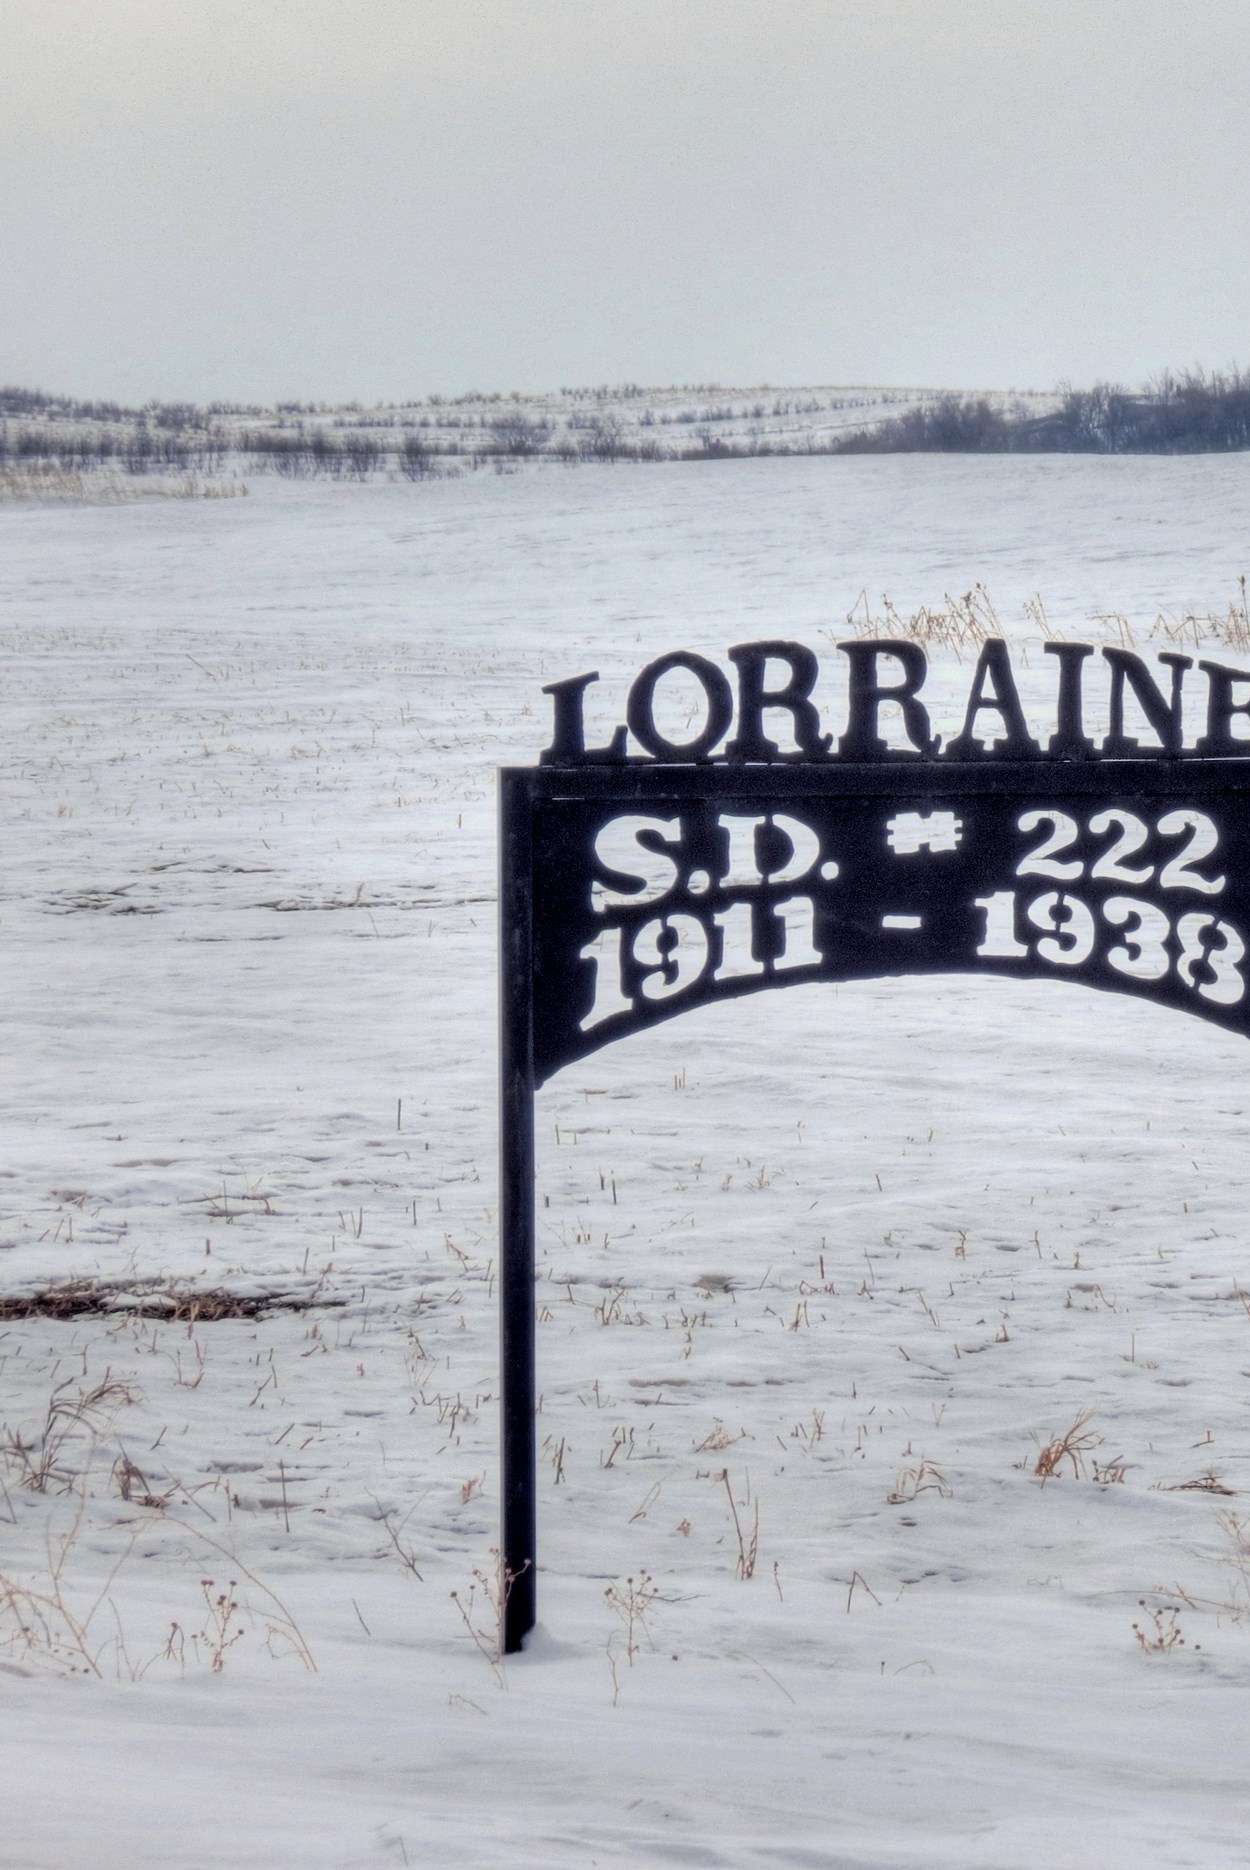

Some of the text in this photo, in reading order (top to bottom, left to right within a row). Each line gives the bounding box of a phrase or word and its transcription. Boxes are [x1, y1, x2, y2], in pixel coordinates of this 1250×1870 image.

[592, 809, 1226, 912] S.D. # 222
[579, 891, 1246, 1032] 1911 - 1938
